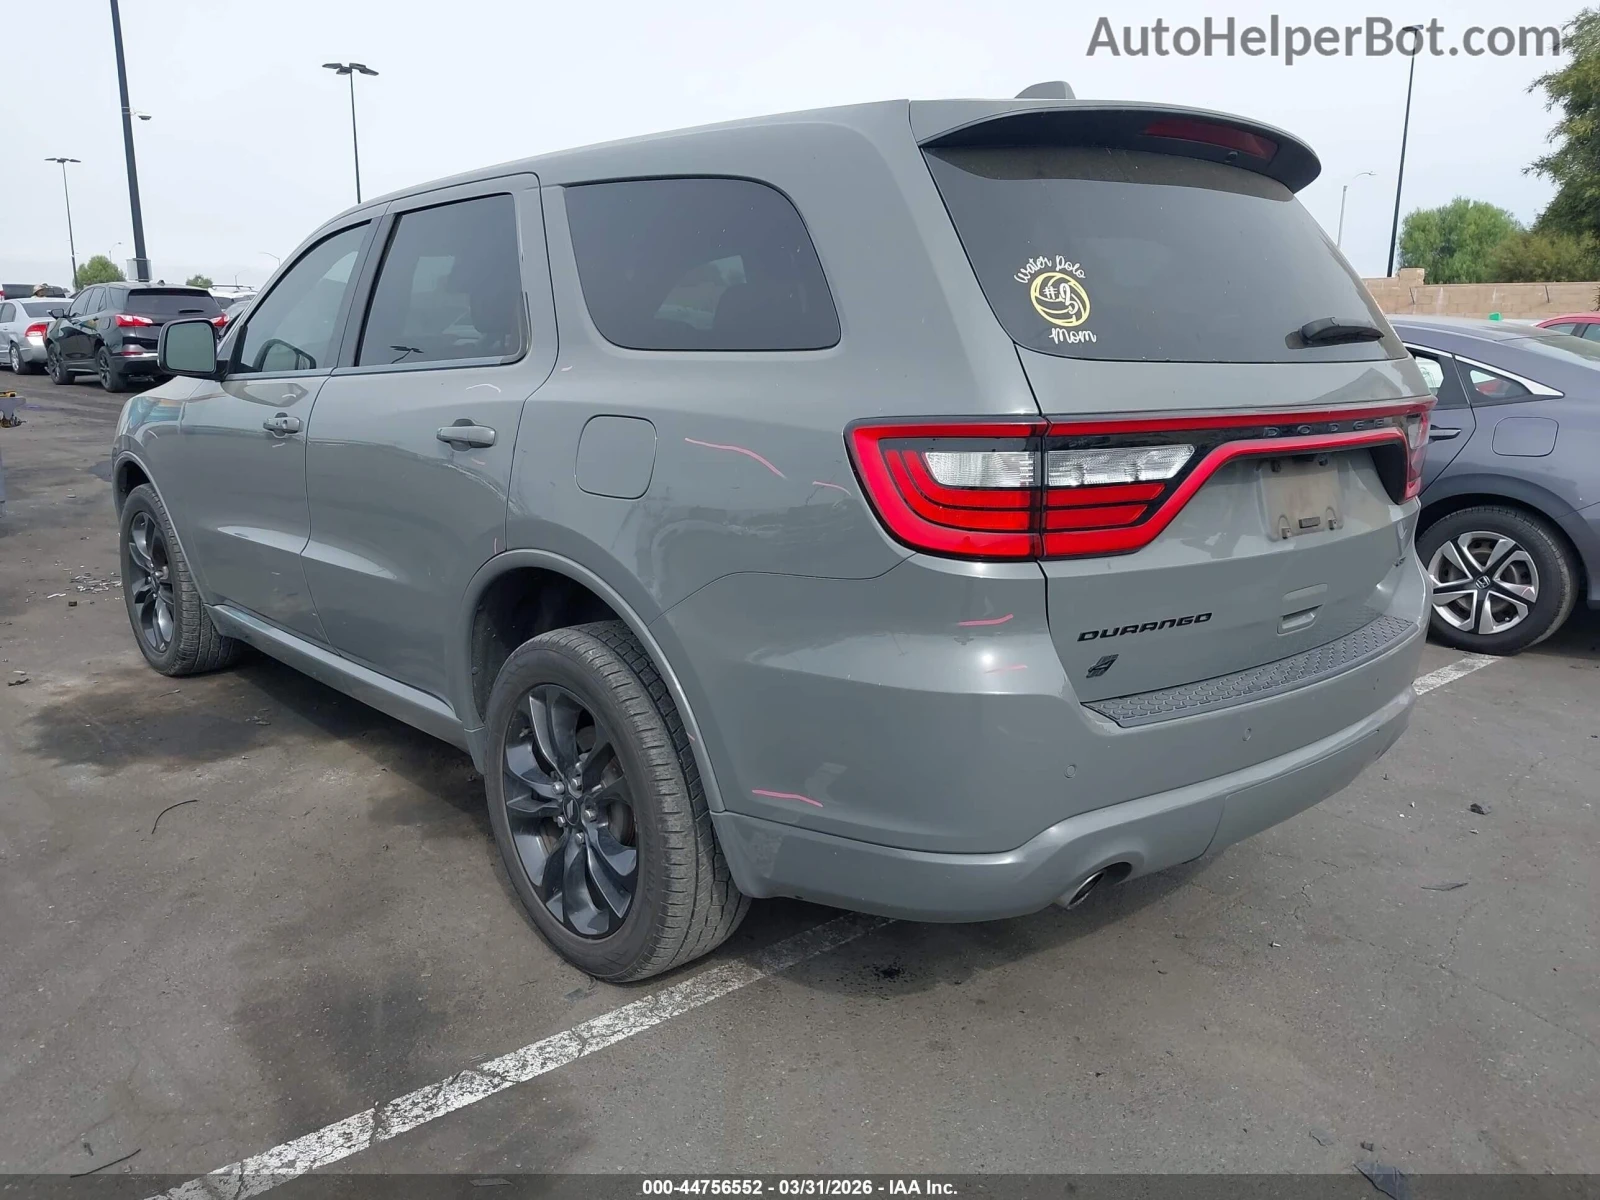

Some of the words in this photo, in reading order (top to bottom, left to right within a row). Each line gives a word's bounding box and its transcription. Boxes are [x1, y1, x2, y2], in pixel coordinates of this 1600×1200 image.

[1013, 256, 1052, 284] Water
[1055, 254, 1086, 279] Polo
[1048, 327, 1097, 345] Mom
[1263, 418, 1385, 438] DODGE
[1077, 612, 1213, 642] DURANGO
